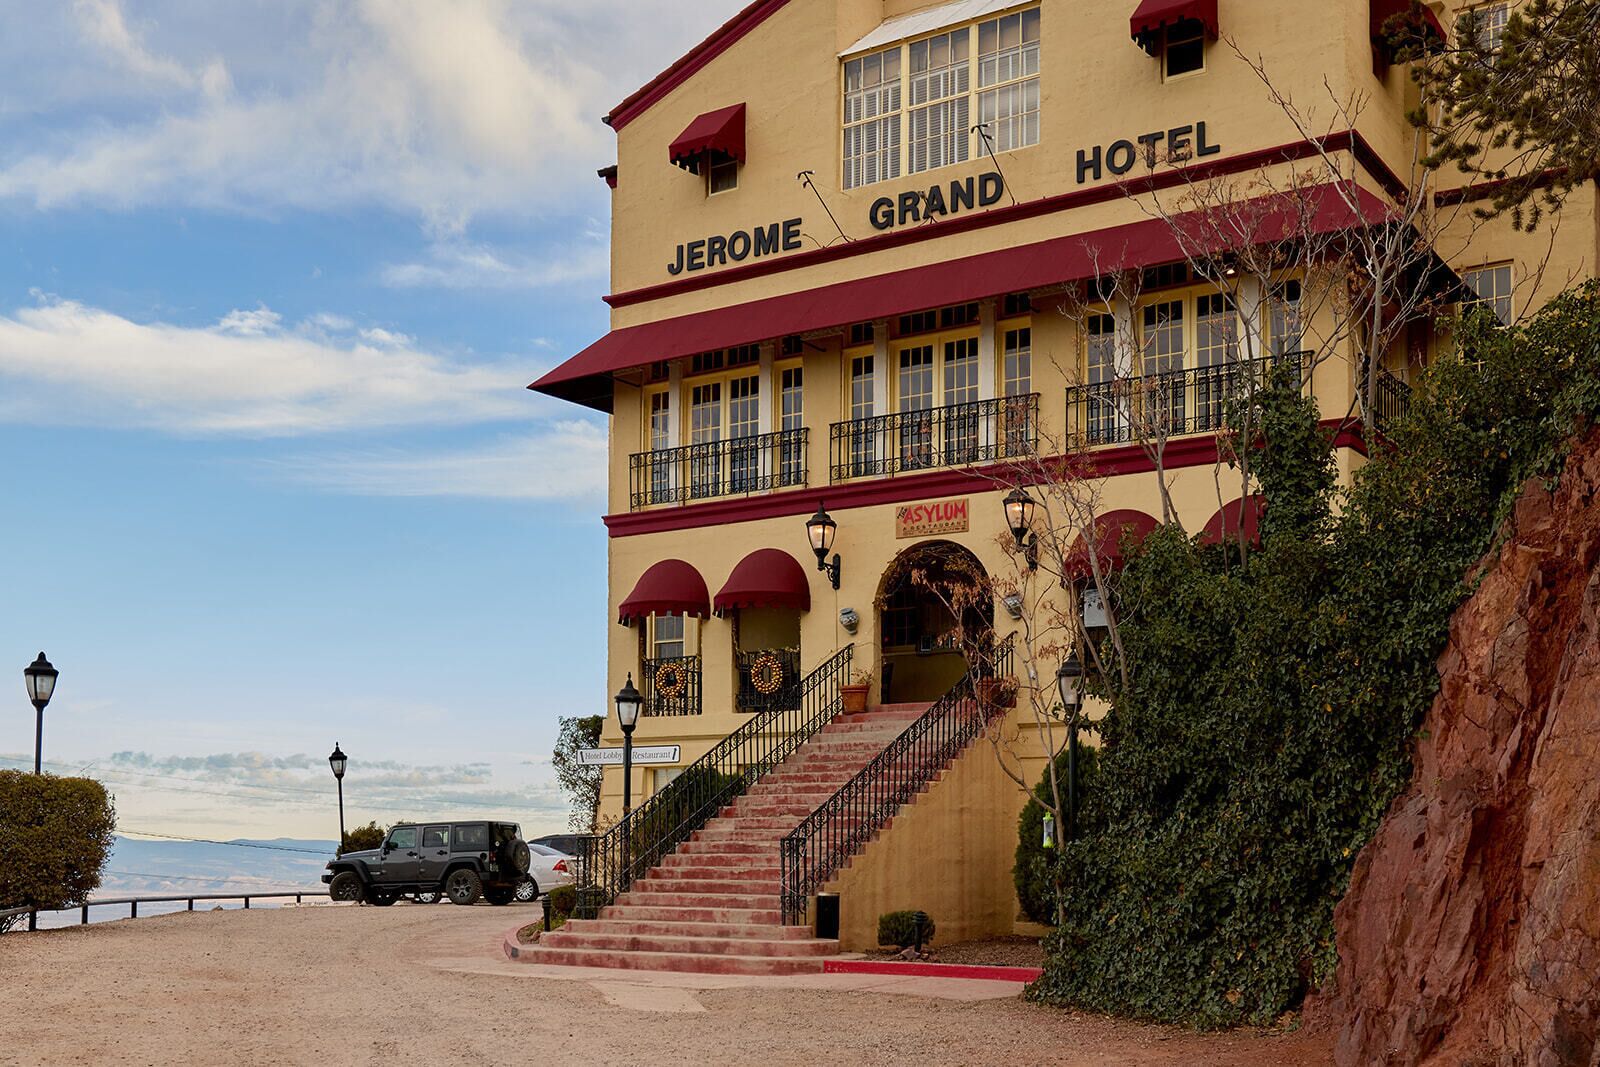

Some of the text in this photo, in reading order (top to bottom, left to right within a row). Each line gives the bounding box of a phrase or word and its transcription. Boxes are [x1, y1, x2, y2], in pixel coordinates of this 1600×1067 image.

[667, 121, 1220, 276] JEROME GRAND HOTEL
[903, 501, 966, 524] ASYLUM
[910, 520, 967, 531] RESTAURANT
[585, 750, 671, 761] Hotel Lobby Restaurant
